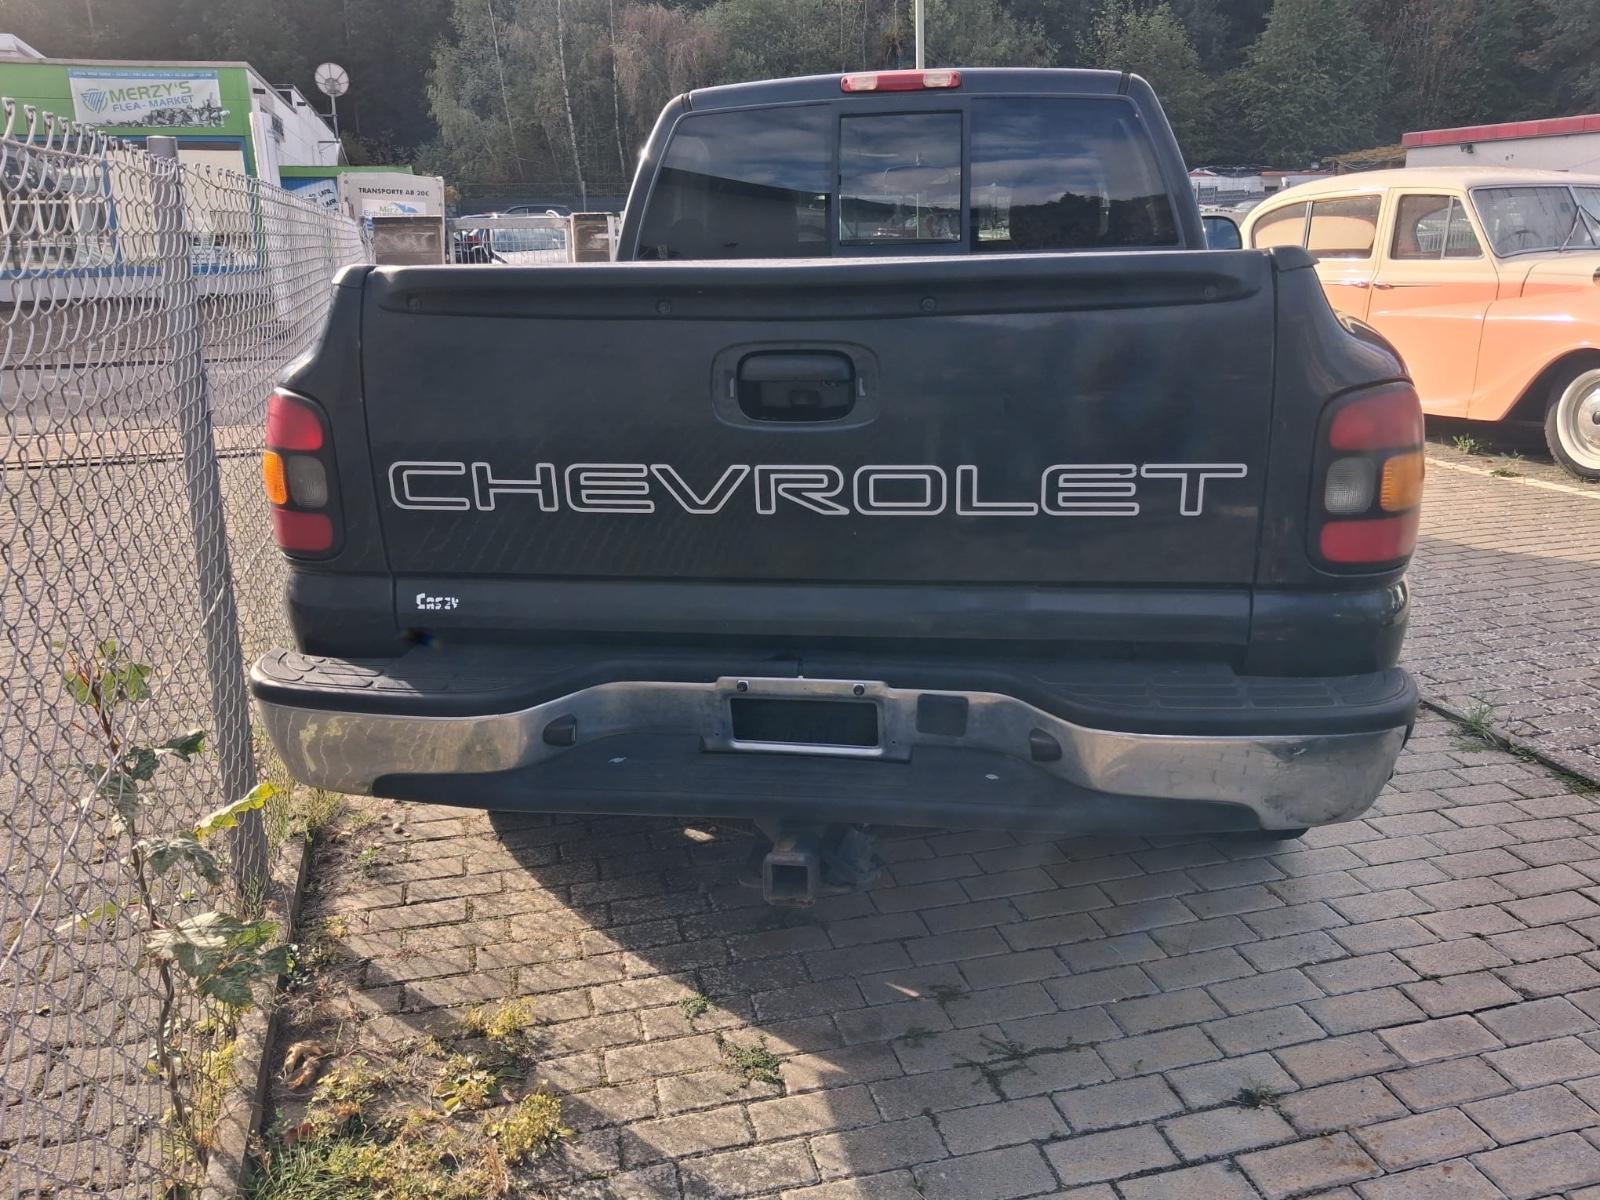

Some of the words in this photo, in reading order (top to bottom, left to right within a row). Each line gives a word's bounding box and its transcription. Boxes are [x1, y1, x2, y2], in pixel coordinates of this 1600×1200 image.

[109, 81, 192, 103] MERZY'S
[112, 102, 142, 112] FLEA
[148, 95, 194, 108] MARKET
[358, 187, 403, 196] TRANSPORTE
[388, 461, 1248, 518] CHEVROLET
